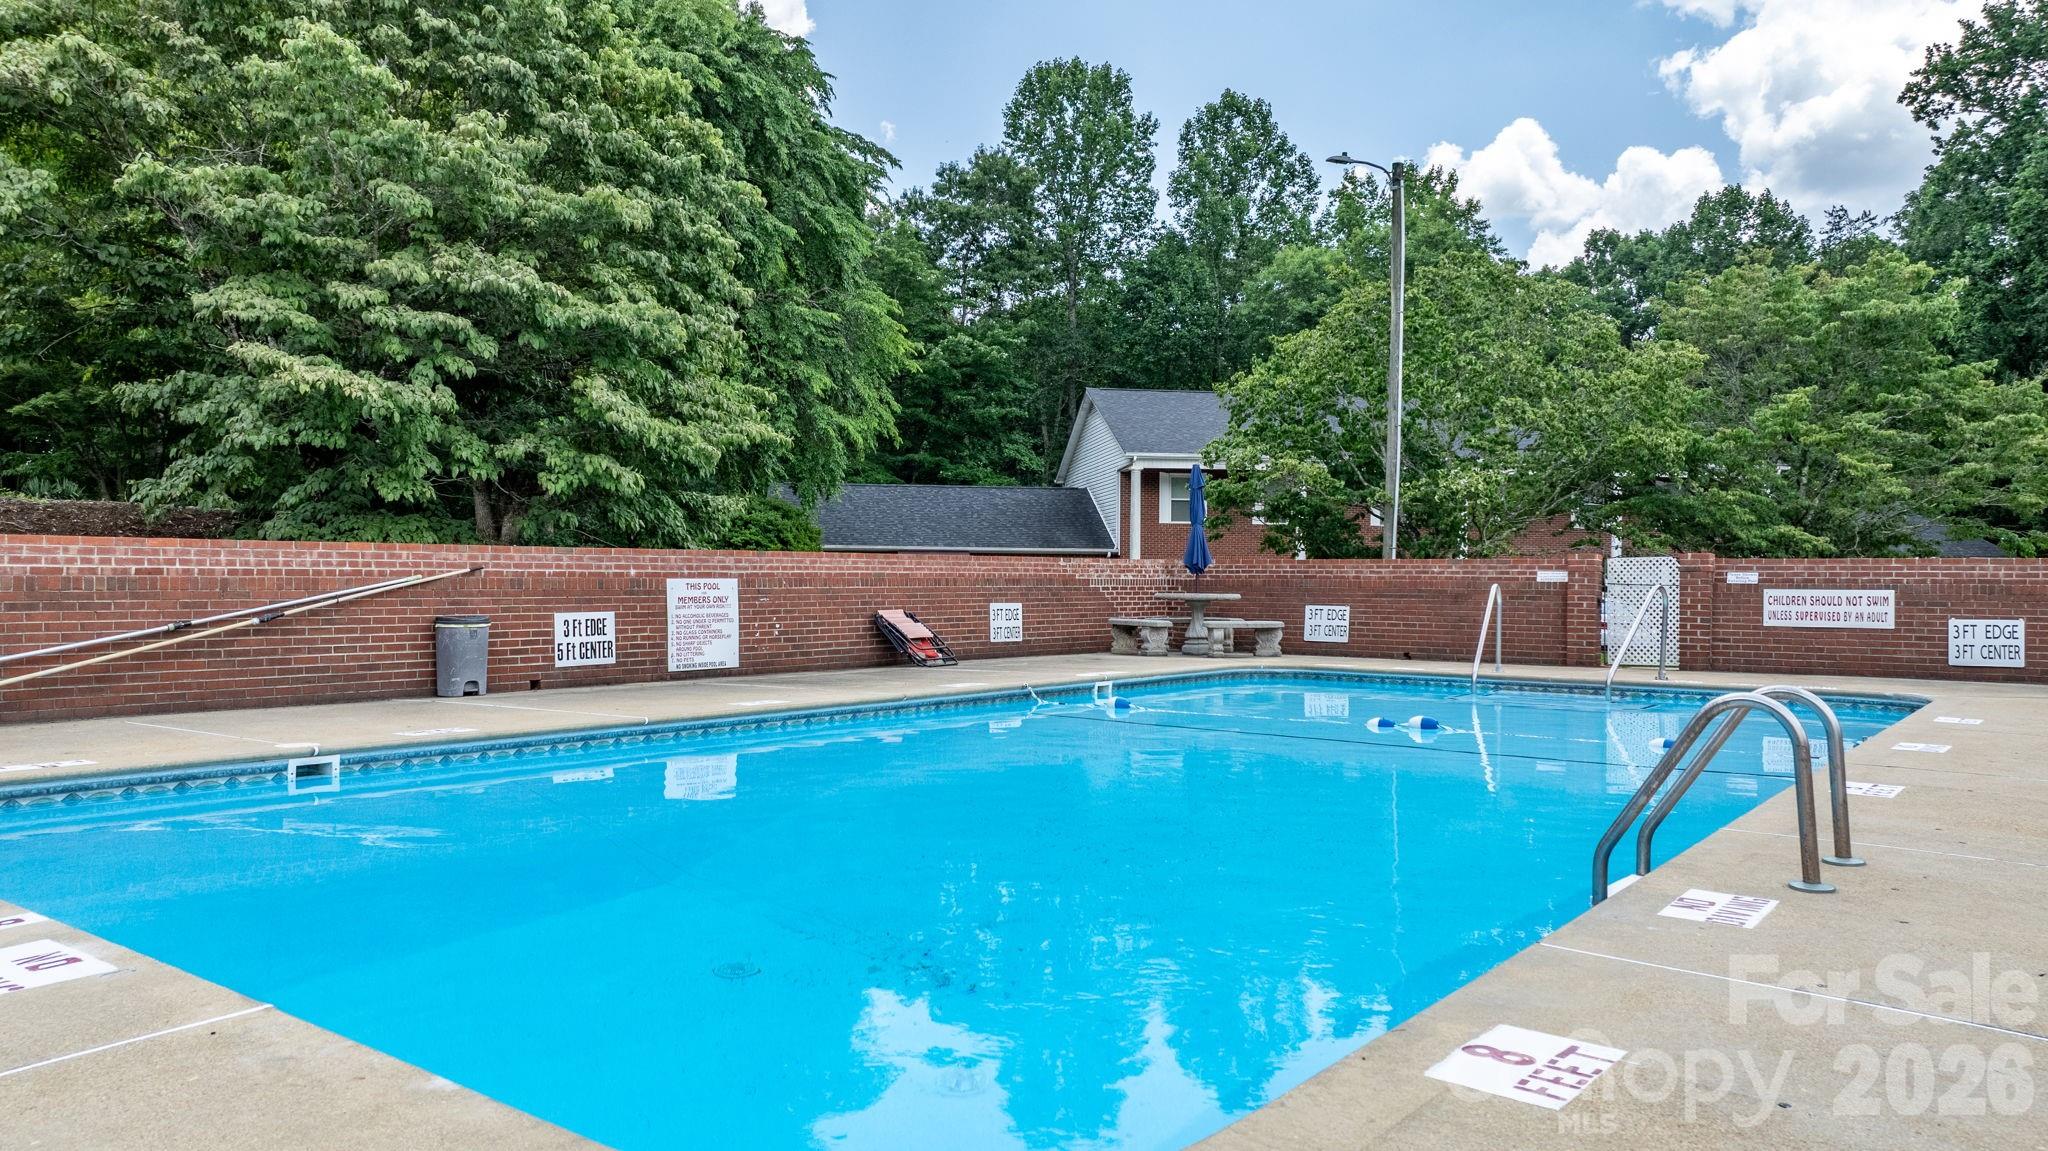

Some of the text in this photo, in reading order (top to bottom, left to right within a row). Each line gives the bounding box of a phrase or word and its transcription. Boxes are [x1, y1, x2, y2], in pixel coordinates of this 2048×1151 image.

[686, 582, 720, 590] THIS POOL
[678, 596, 711, 604] MEMBERS
[1767, 595, 1889, 607] CHILDREN SHOULD NOT SWIM
[992, 608, 1019, 621] 3 FT EDGE
[1308, 608, 1346, 621] 3 FT EDGE
[1767, 610, 1889, 623] UNLESS SUPERVISED BY AN ADULT
[564, 619, 569, 637] 3
[585, 618, 607, 636] EDGE
[1308, 624, 1347, 637] 3 FT CENTER
[1953, 624, 2019, 640] 3 FT EDGE
[557, 642, 563, 661] 5
[579, 640, 613, 659] CENTER
[1954, 644, 2021, 660] 3 FT CENTER
[1461, 1044, 1537, 1066] 8
[1513, 1045, 1617, 1101] FEET
